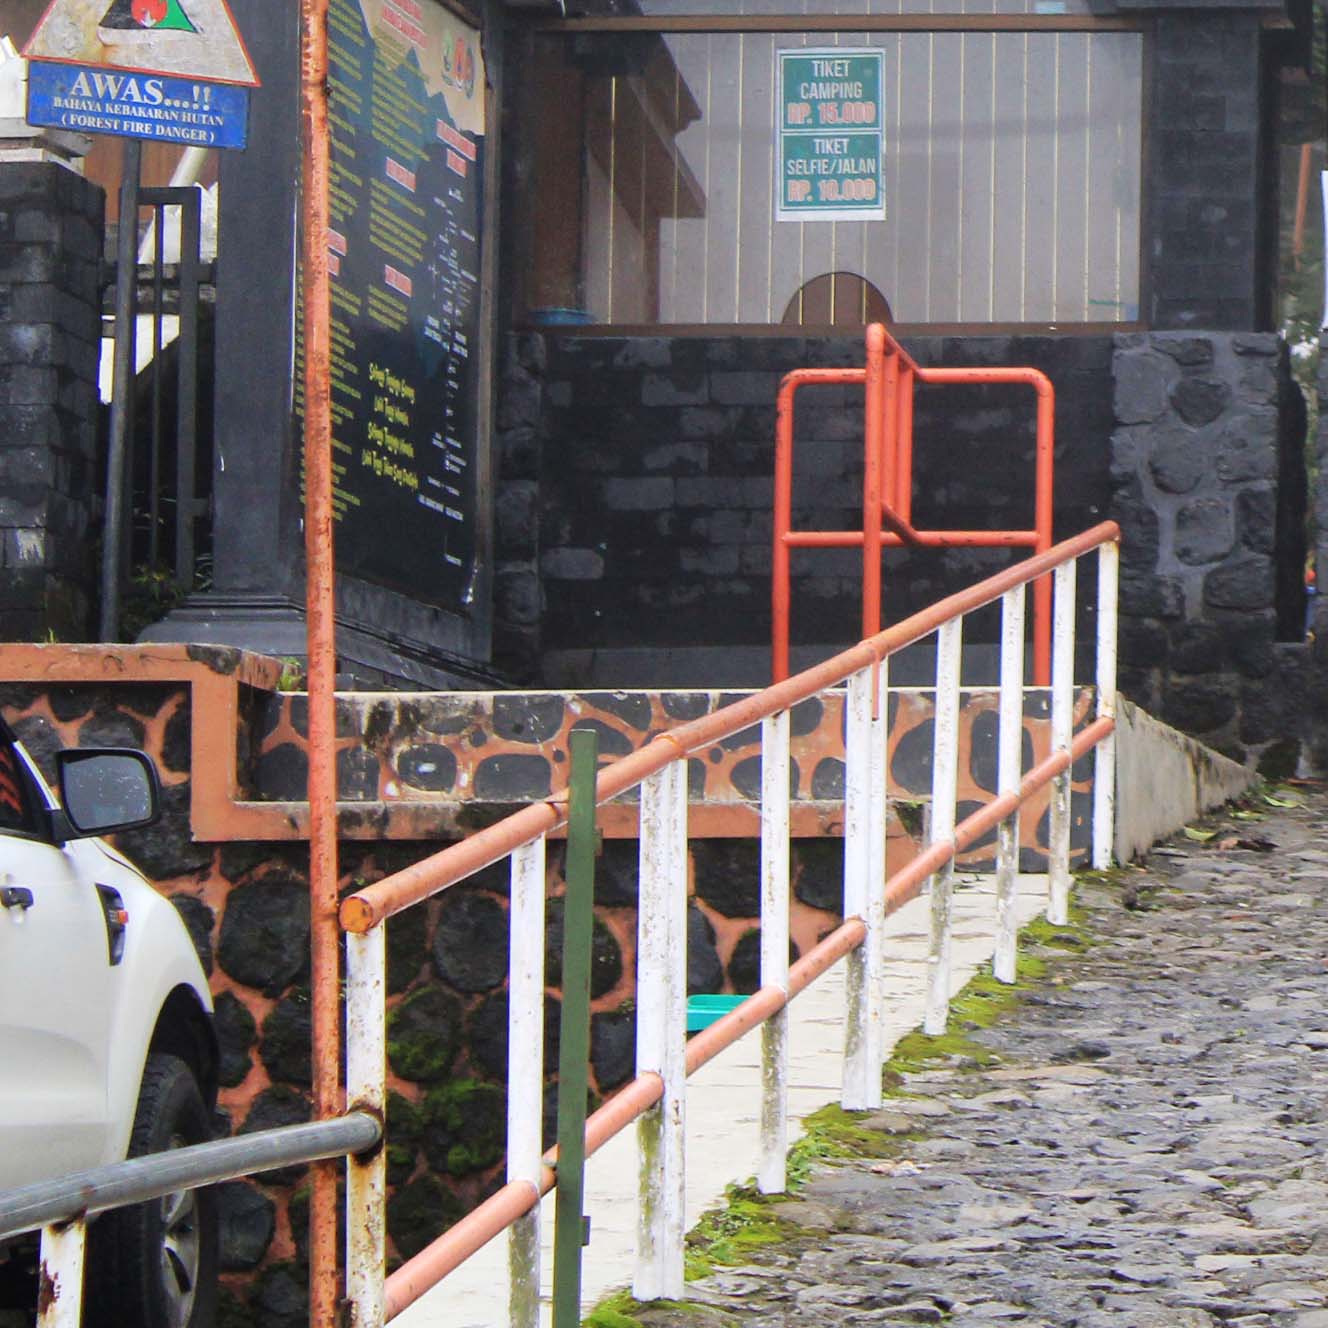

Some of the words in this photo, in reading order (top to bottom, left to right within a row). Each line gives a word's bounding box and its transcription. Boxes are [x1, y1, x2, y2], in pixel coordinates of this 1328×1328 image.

[812, 60, 851, 77] TIKET
[800, 82, 863, 100] CAMPING
[53, 96, 101, 113] BAHAYA
[105, 102, 180, 121] KEBAKARAN
[182, 110, 224, 126] HUTAN
[787, 102, 813, 124] RP.
[818, 101, 876, 124] 15.000
[123, 121, 152, 135] FIRE
[813, 138, 849, 154] TIKET
[787, 158, 876, 175] SELFIE/JALAN
[787, 180, 813, 202] RP.
[818, 179, 876, 201] 10.000
